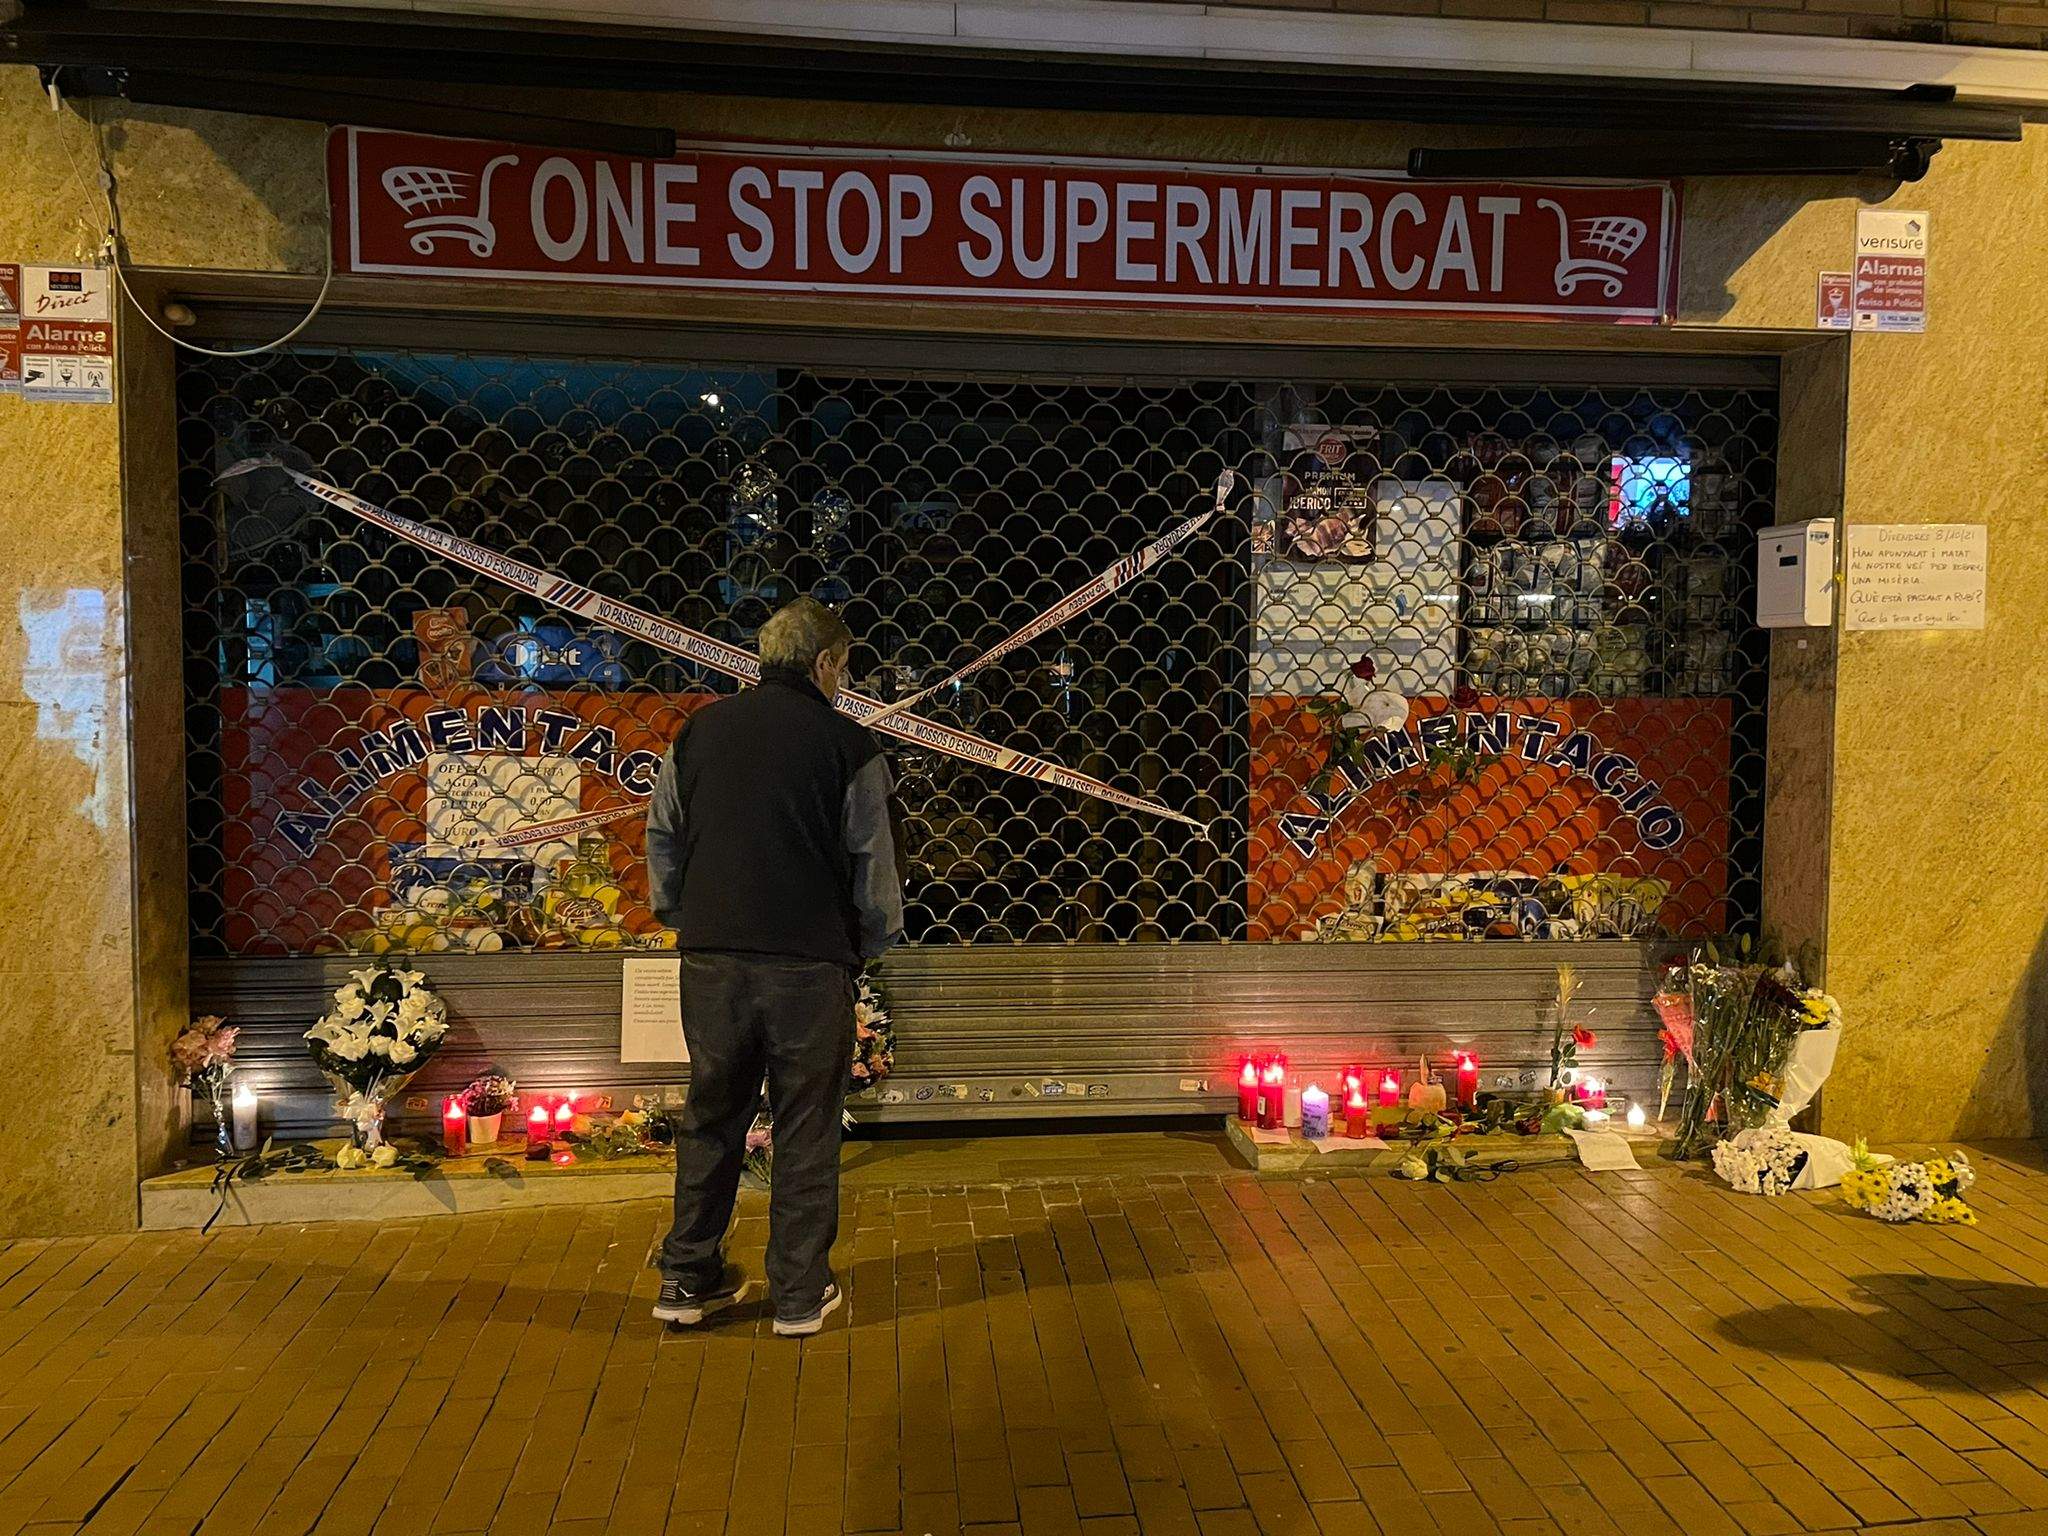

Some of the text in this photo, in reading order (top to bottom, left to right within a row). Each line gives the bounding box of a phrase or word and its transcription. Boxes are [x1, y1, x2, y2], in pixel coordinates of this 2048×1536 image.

[531, 157, 1521, 292] ONE STOP SUPERMERCAT
[1860, 237, 1923, 249] verisure
[1860, 260, 1923, 276] Alarma
[35, 291, 98, 313] Direct
[27, 324, 106, 342] Alarma
[43, 343, 68, 351] Aviso
[449, 540, 484, 565] MOSSOS
[596, 601, 762, 679] NO PASSEU POLICIA MOSSOS D'ESQUA
[914, 723, 949, 747] MOSSOS
[948, 735, 999, 764] D'ESQUADRA
[274, 705, 664, 859] ALIMENTAC
[551, 819, 589, 833] MOSSOS
